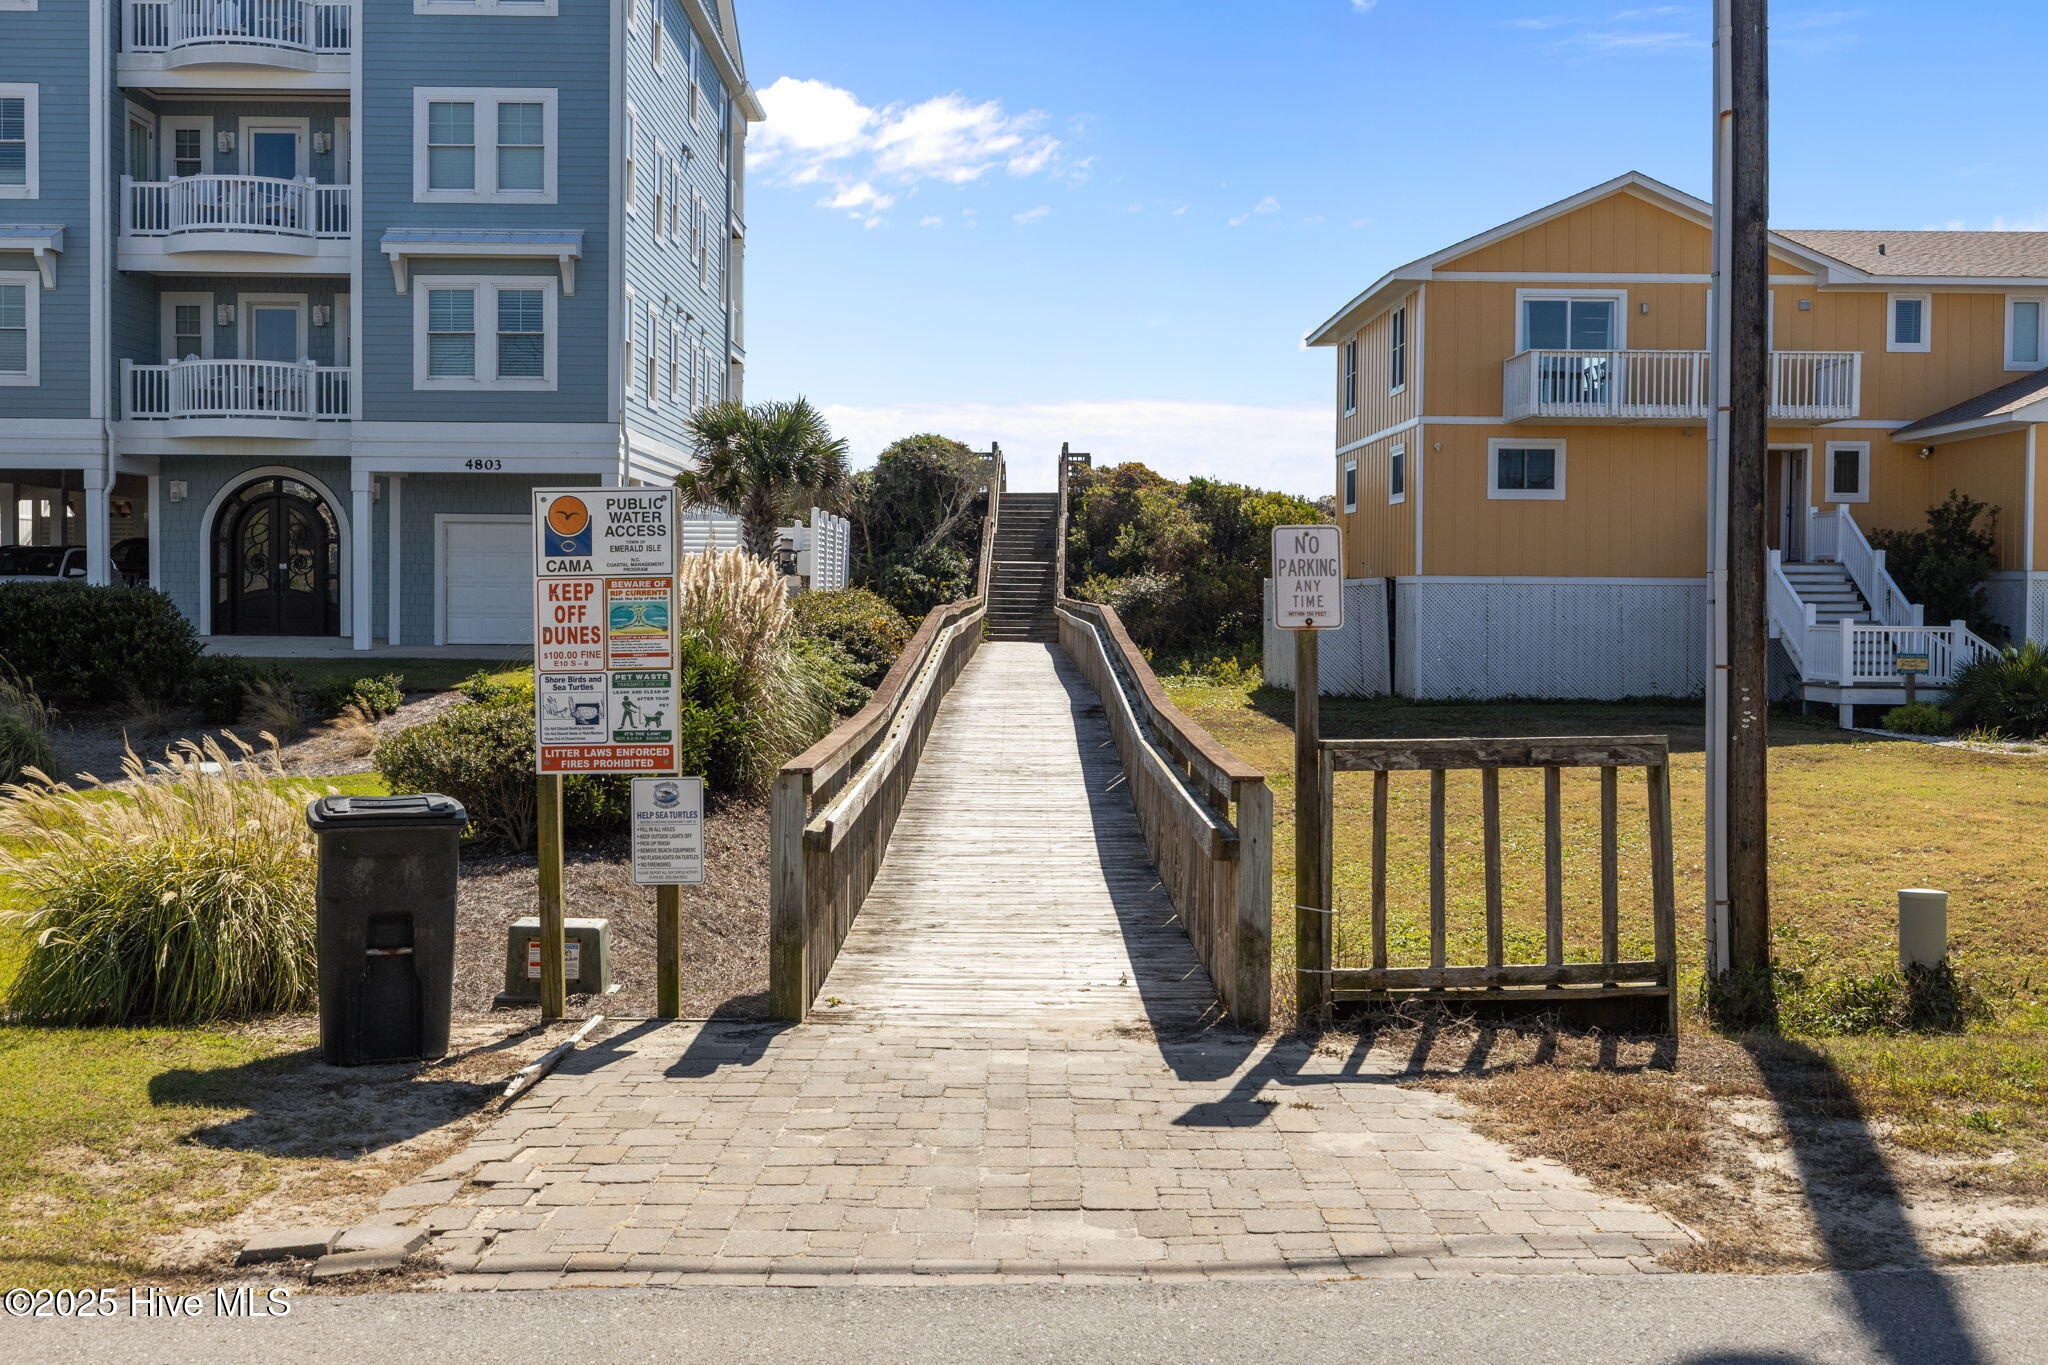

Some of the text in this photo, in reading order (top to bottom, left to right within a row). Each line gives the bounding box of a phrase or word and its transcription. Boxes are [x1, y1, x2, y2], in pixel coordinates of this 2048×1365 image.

[464, 458, 502, 470] 4803
[606, 498, 664, 510] PUBLIC
[608, 511, 662, 523] WATER
[604, 524, 666, 537] ACCESS
[1295, 536, 1319, 554] NO
[546, 560, 593, 572] CAMA
[1278, 558, 1336, 577] PARKING
[548, 583, 594, 601] KEEP
[1295, 580, 1320, 592] ANY
[1292, 595, 1324, 607] TIME
[554, 605, 587, 624] OFF
[542, 626, 601, 645] DUNES
[544, 650, 602, 659] $100.00 FINE
[545, 748, 669, 758] LITTER LAWS ENFORCED
[561, 759, 654, 768] FIRES PROHIBITED
